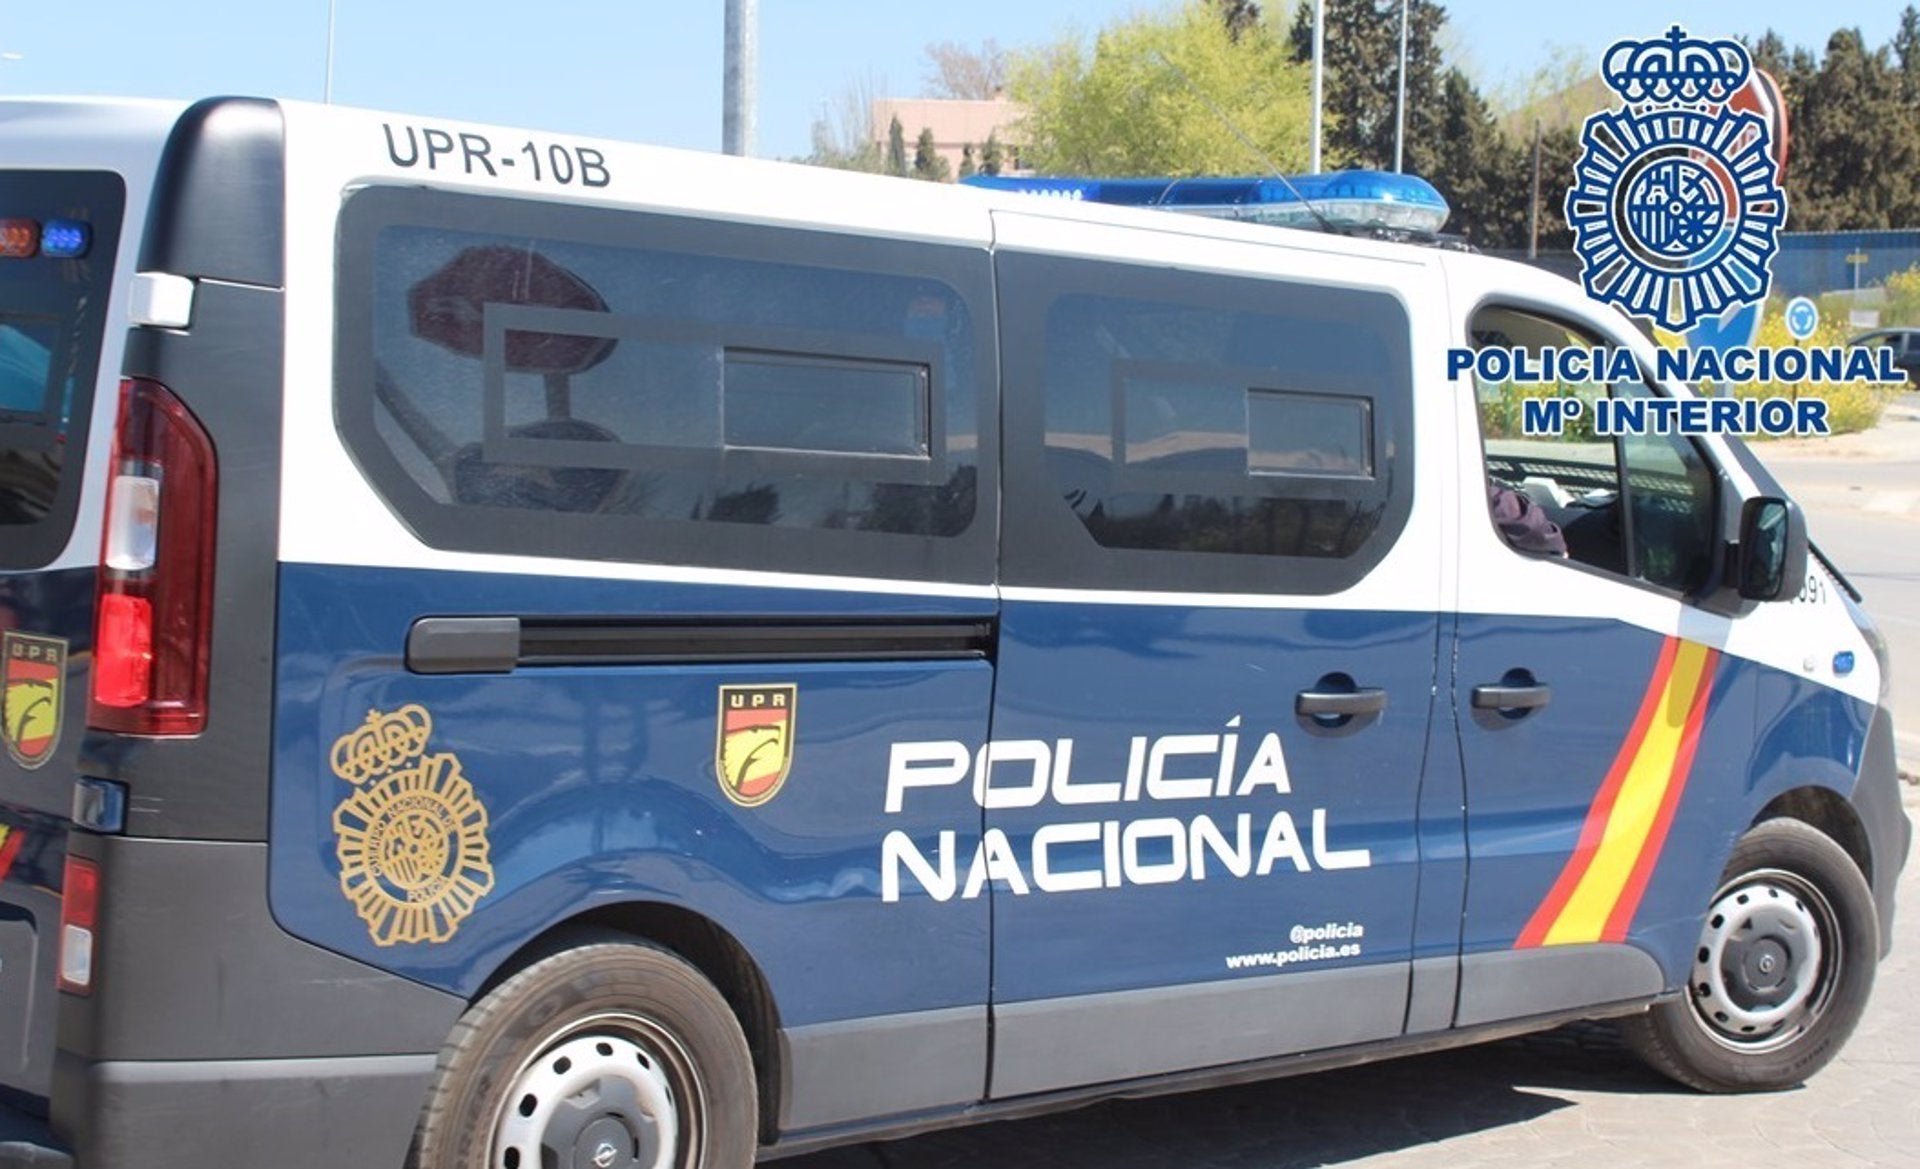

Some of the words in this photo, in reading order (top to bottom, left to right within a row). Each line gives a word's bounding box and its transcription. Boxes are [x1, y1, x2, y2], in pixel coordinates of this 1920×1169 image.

[383, 123, 611, 188] UPR-10B
[731, 694, 785, 707] UPR
[884, 715, 1292, 813] POLICÍA
[882, 808, 1371, 902] NACIONAL
[1290, 922, 1364, 943] @policia
[1226, 943, 1361, 968] www.policia.es
